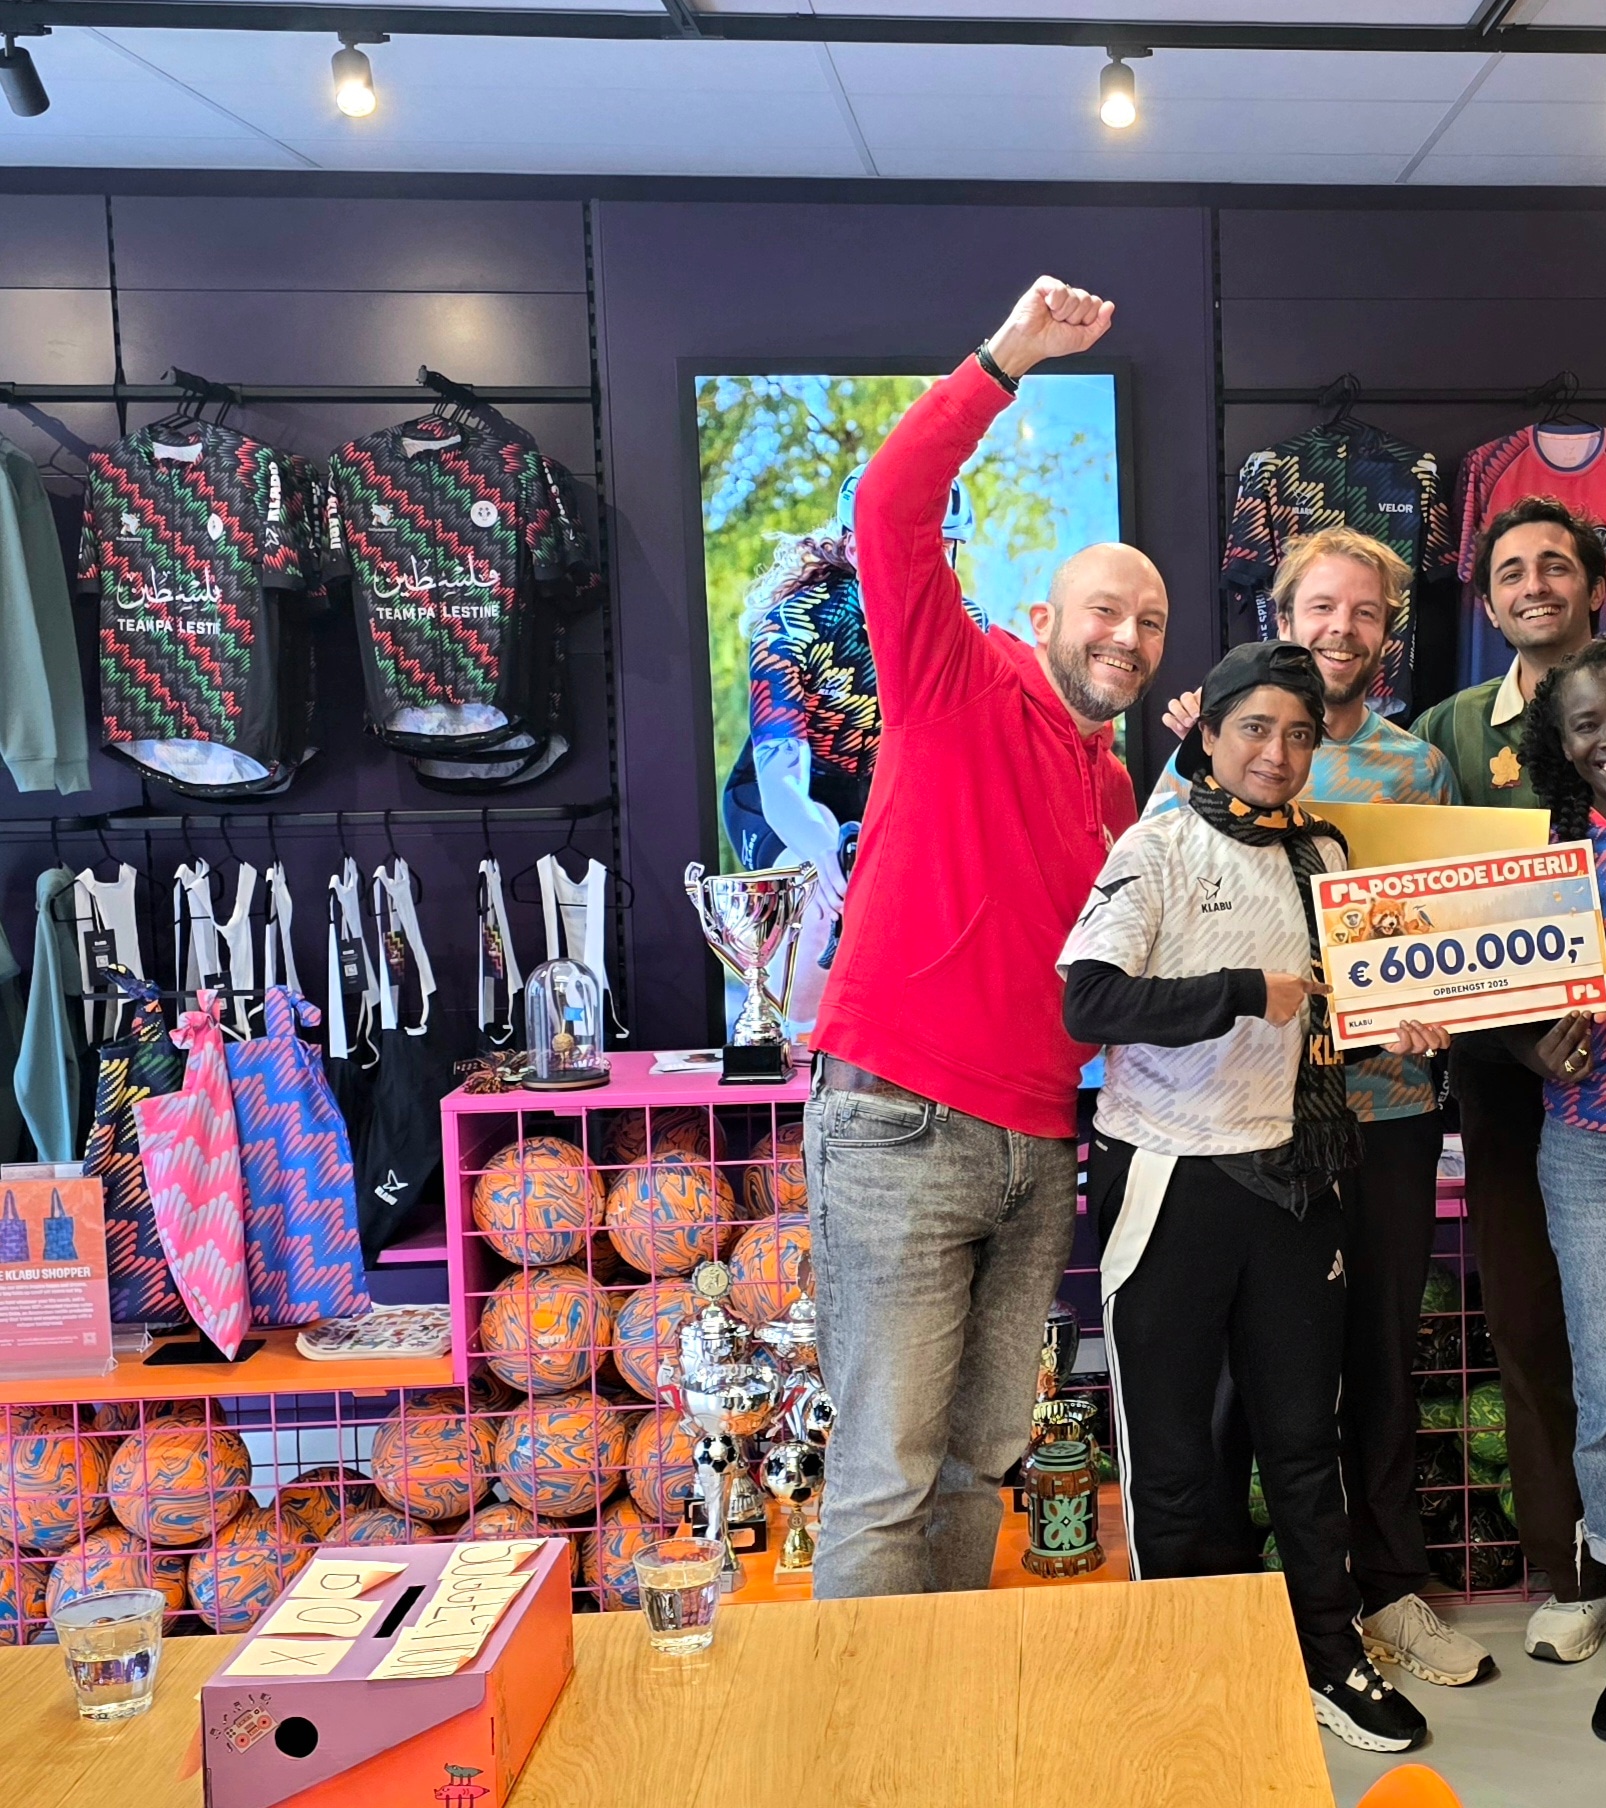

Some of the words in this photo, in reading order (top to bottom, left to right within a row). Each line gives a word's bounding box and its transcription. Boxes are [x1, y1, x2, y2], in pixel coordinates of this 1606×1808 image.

[1378, 502, 1414, 513] VELOR
[1368, 867, 1490, 897] POSTCODE
[1491, 852, 1579, 883] LOTERIJ
[1201, 900, 1233, 914] KLABU
[1348, 959, 1373, 988] €
[1379, 924, 1586, 984] 600.000,-
[1432, 981, 1486, 997] OPBRENGST
[1487, 978, 1510, 990] 2025
[1348, 1018, 1374, 1029] KLABU
[1309, 1034, 1345, 1066] KLA
[5, 1268, 40, 1281] KLABU
[41, 1266, 92, 1280] SHOPPER
